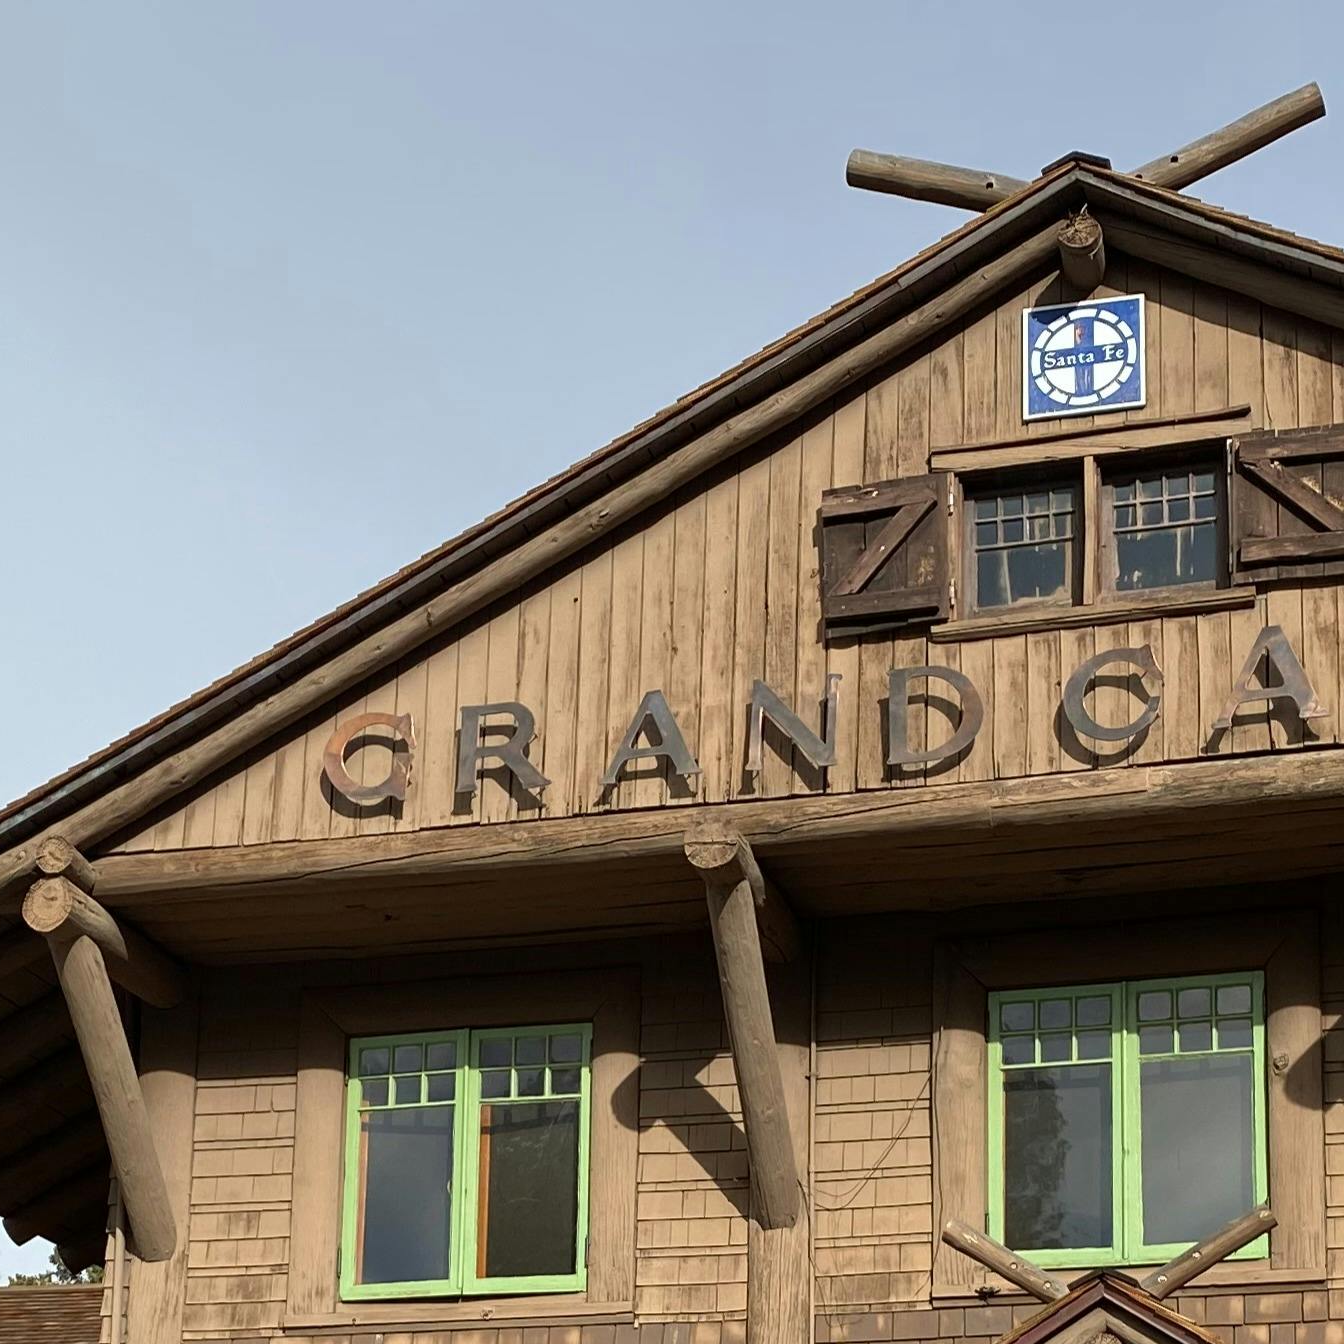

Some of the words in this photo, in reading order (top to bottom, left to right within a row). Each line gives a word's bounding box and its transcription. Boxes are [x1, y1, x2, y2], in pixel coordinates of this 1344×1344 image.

[1044, 352, 1094, 368] Santa
[1102, 346, 1125, 360] Fe
[323, 665, 982, 801] GRAND
